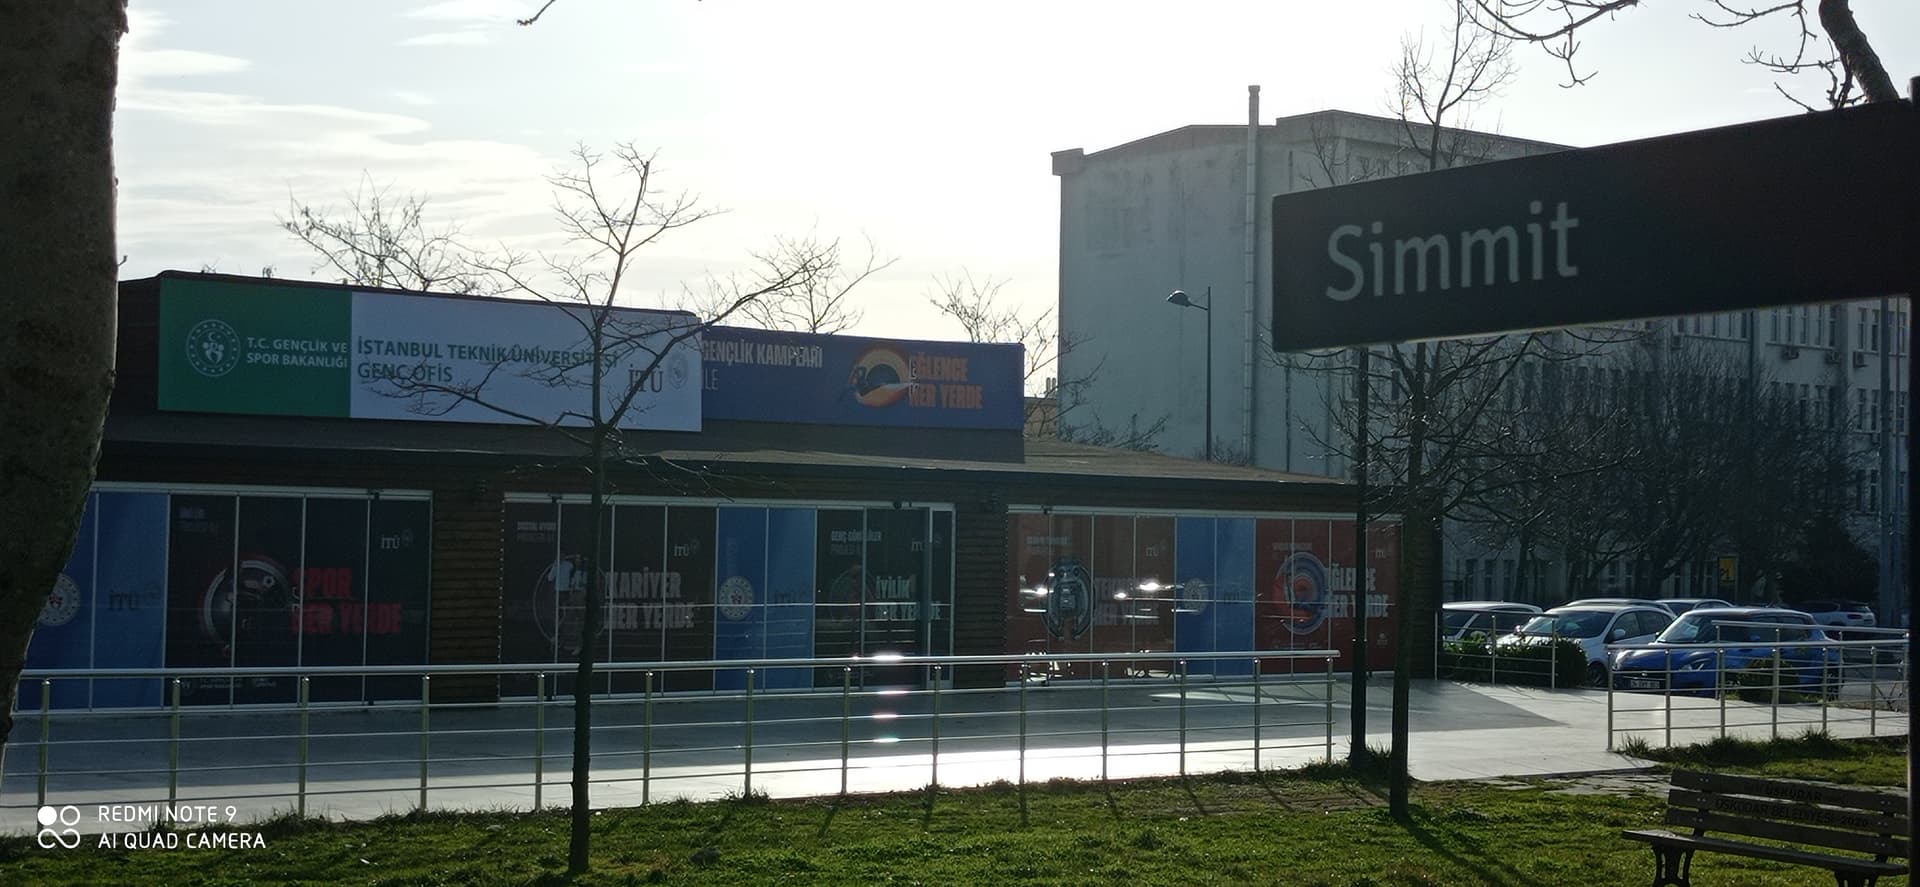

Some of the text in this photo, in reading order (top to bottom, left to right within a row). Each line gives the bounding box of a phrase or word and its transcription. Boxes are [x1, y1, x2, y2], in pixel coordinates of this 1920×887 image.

[1325, 200, 1579, 301] Simmit
[247, 337, 347, 354] T.C. GENÇLİK VE
[358, 336, 617, 368] İSTANBUL TEKNİK ÜNİVERSİTSİ
[247, 352, 347, 368] SPOR BAKANLIĞI
[414, 362, 453, 383] OFİS
